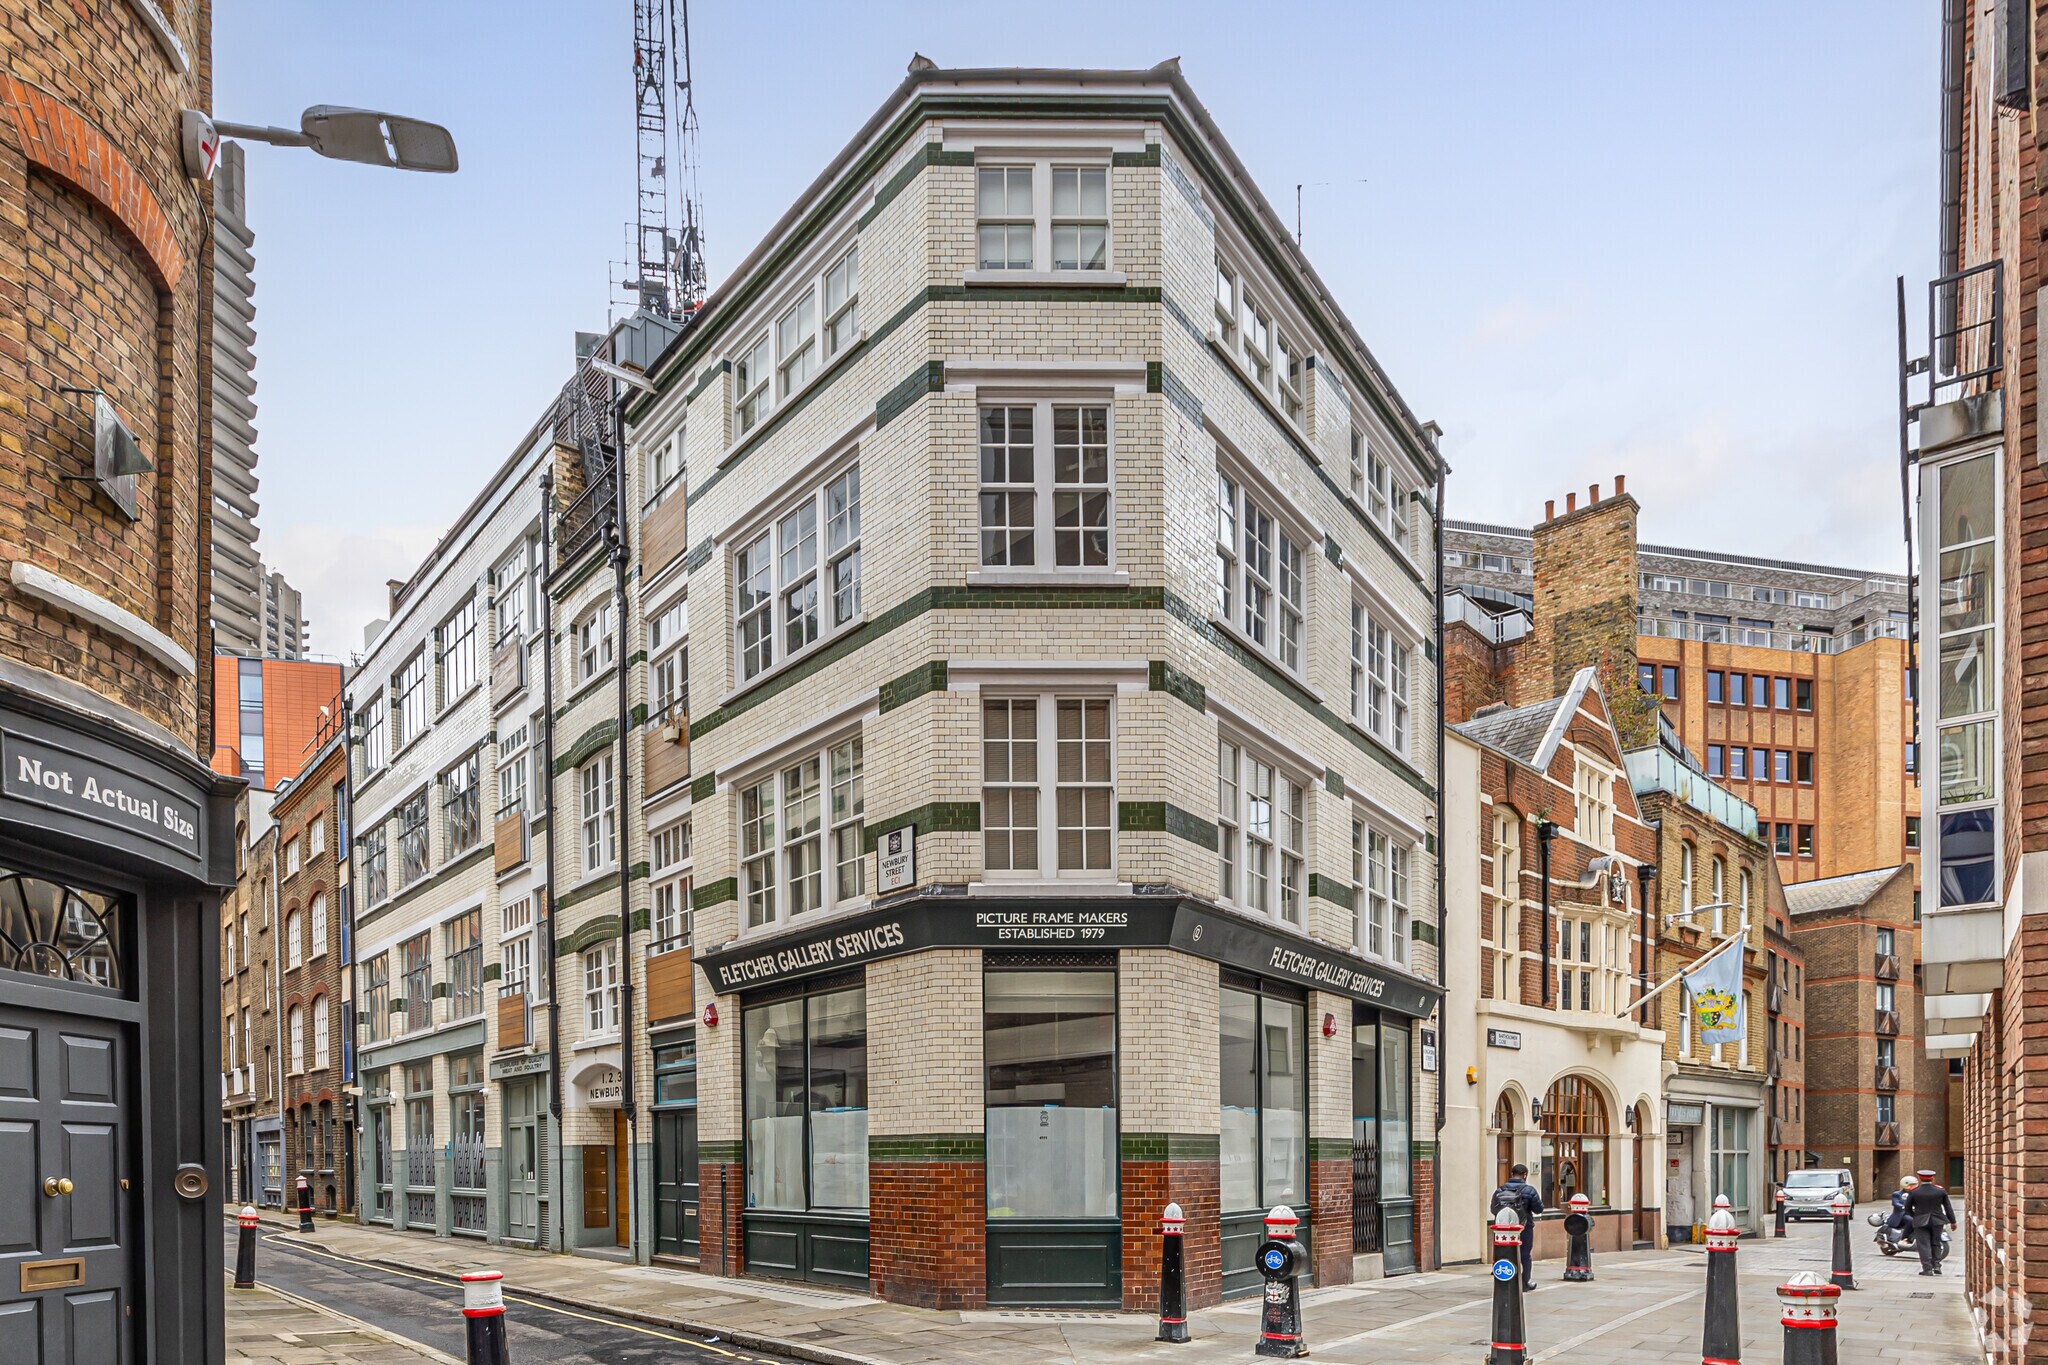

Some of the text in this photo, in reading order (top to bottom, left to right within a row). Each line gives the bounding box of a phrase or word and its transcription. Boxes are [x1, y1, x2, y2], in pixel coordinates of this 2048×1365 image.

[17, 755, 195, 840] Not Actual Size
[882, 854, 909, 869] NEWBURY
[885, 865, 905, 878] STREET
[976, 912, 1128, 924] PICTURE FRAME MAKERS
[998, 928, 1105, 939] ESTABLISHED 1979
[719, 922, 904, 986] FLETCHER GALLERY SERVICES
[1269, 946, 1386, 998] FLETCHER GALLERY SERVICES
[528, 1055, 545, 1064] QUALITY
[524, 1062, 542, 1071] POULTRY
